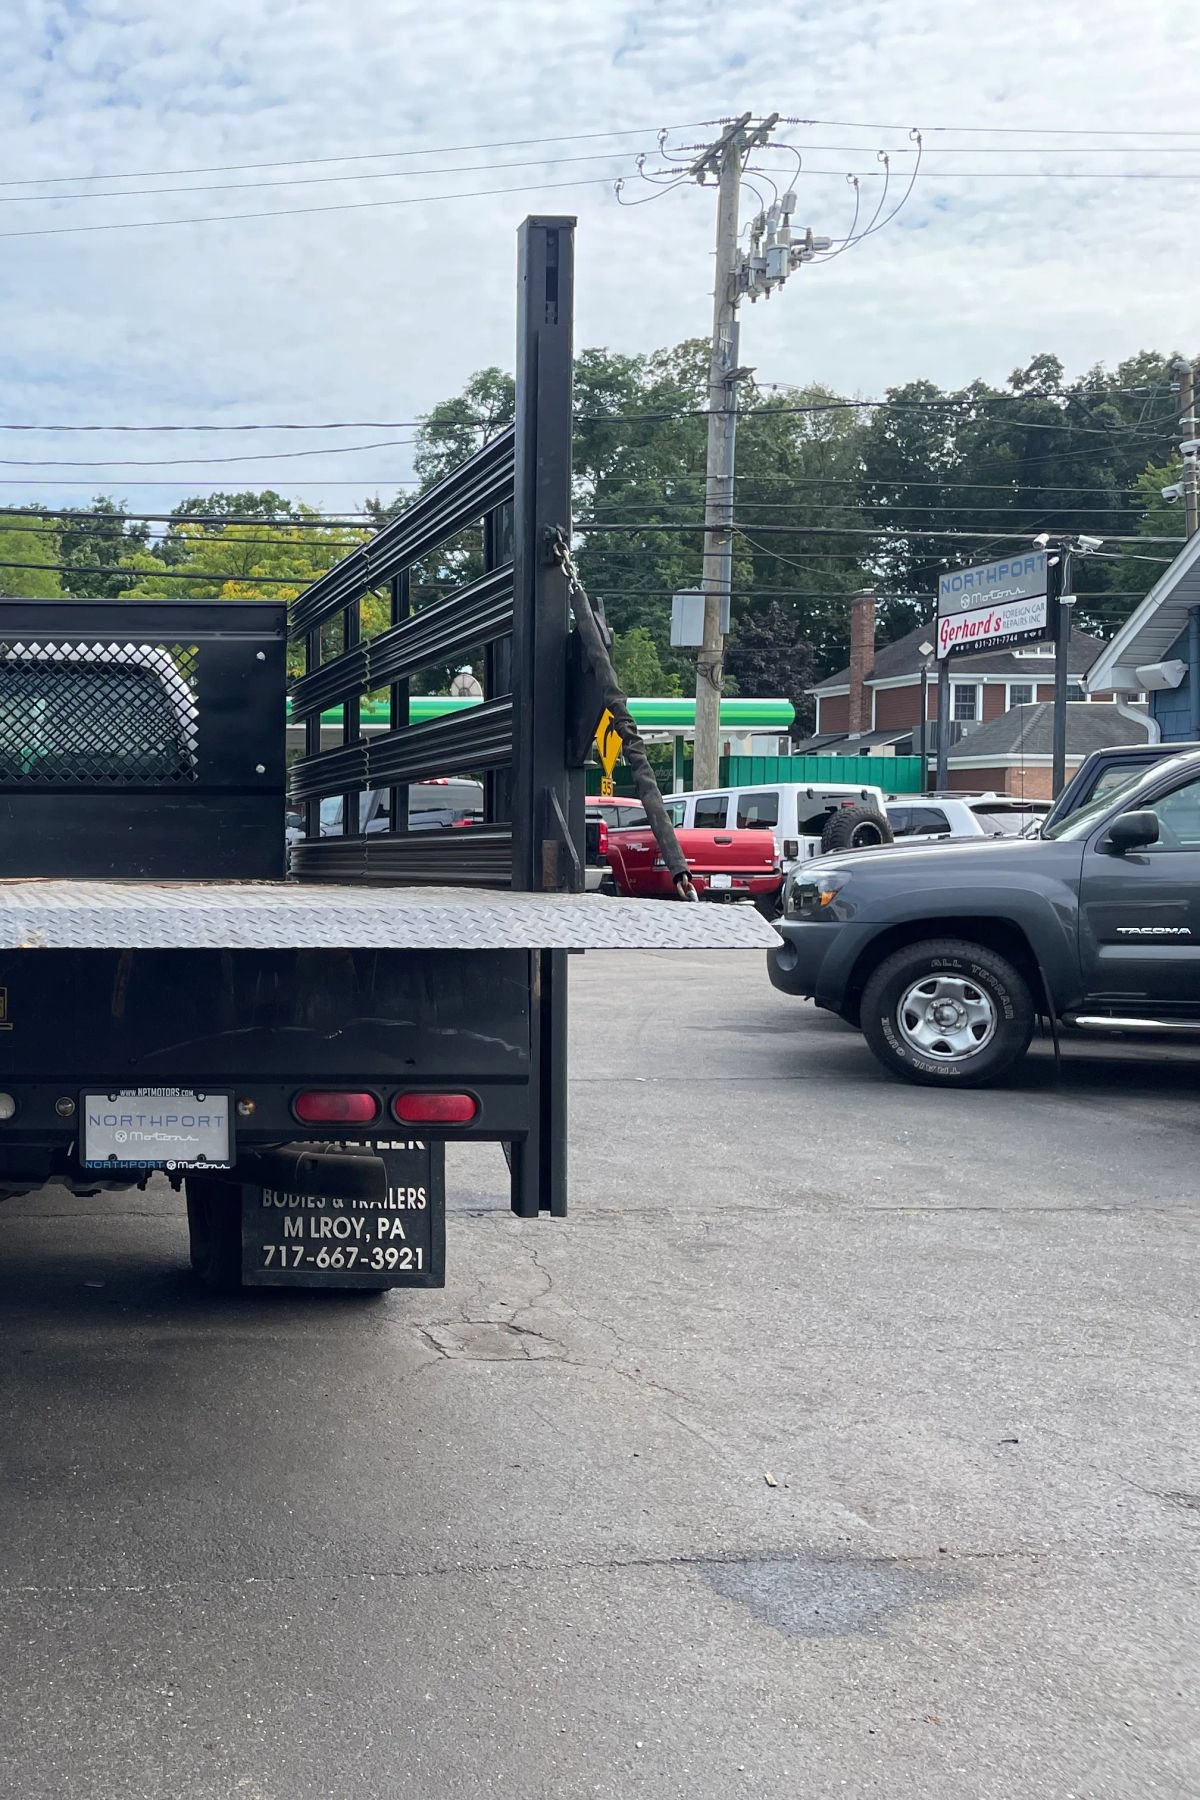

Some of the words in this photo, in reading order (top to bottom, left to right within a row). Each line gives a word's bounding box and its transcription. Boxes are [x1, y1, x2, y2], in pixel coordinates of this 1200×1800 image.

[941, 555, 1046, 594] NORTHPORT
[971, 587, 1026, 604] Motors
[1003, 606, 1031, 618] FOREIGN
[1031, 602, 1045, 613] CAR
[1003, 616, 1028, 629] REPAIRS
[1028, 614, 1041, 623] INC
[941, 611, 1002, 650] Gerhard's
[974, 634, 1018, 649] 631-271-7744
[602, 781, 612, 795] 35
[1116, 927, 1191, 935] TACOMA
[89, 1115, 224, 1127] NORTHPORT
[129, 1132, 199, 1142] Motors
[85, 1161, 163, 1169] NORTHPORT
[177, 1161, 231, 1169] Motors
[377, 1218, 406, 1240] PA
[263, 1245, 424, 1271] 717-667-3921
